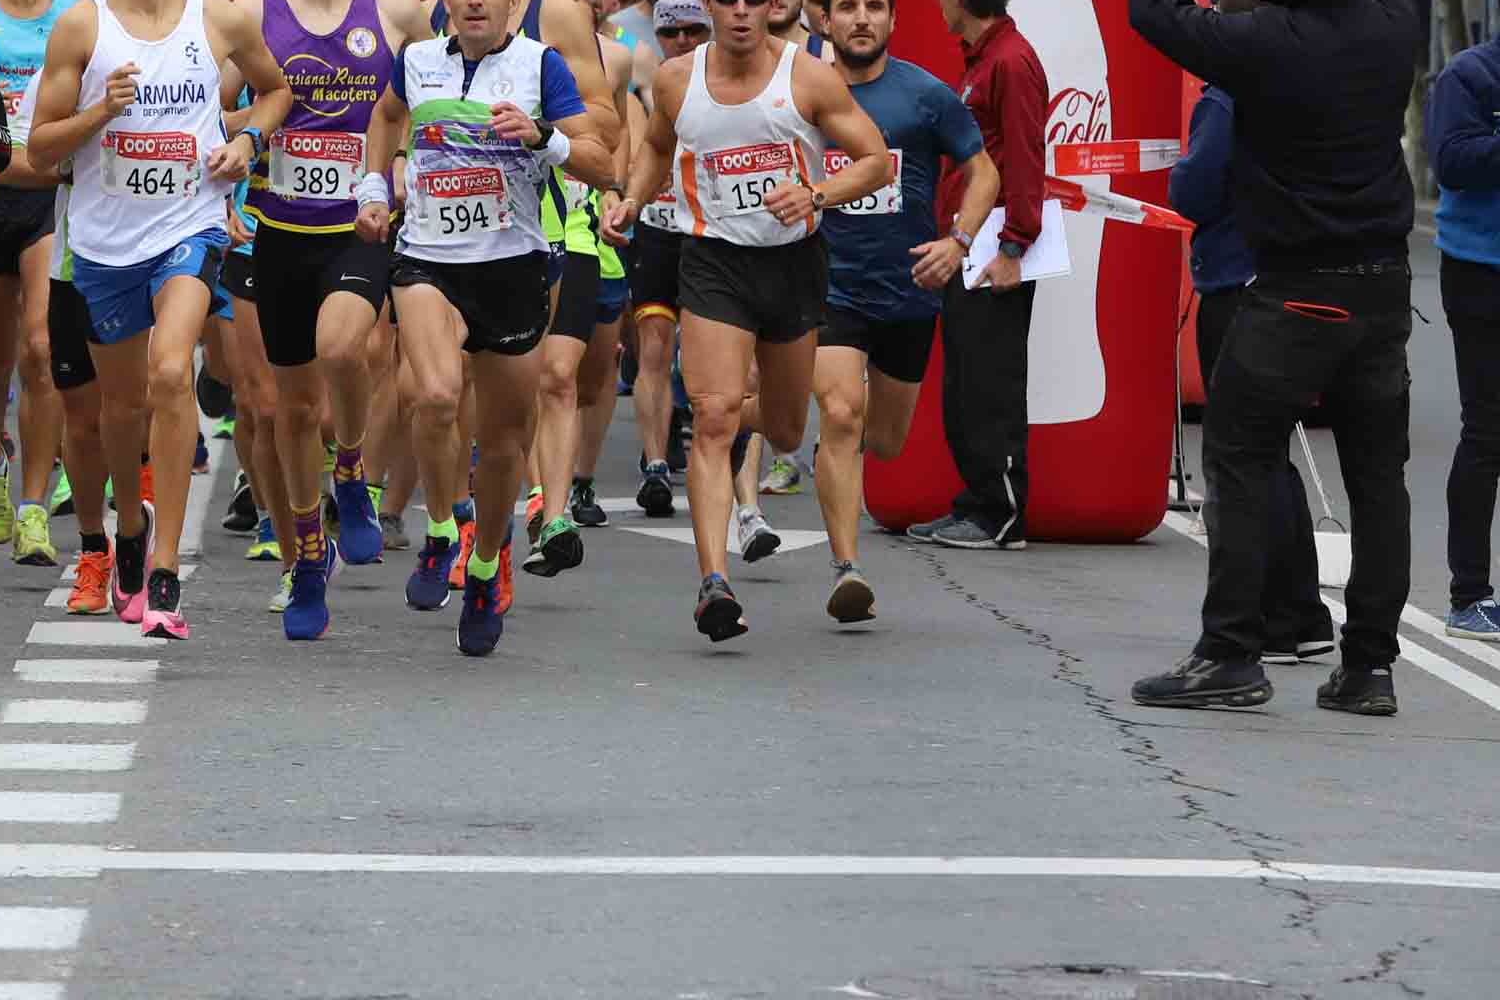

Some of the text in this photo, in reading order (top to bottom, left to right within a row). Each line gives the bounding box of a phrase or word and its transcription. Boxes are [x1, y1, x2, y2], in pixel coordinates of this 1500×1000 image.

[332, 67, 377, 86] Ruano
[134, 79, 207, 105] ARMUÑA
[311, 88, 378, 102] Macotera
[823, 155, 853, 172] 1.00
[125, 167, 176, 195] 464
[292, 165, 340, 196] 389
[439, 201, 490, 235] 594
